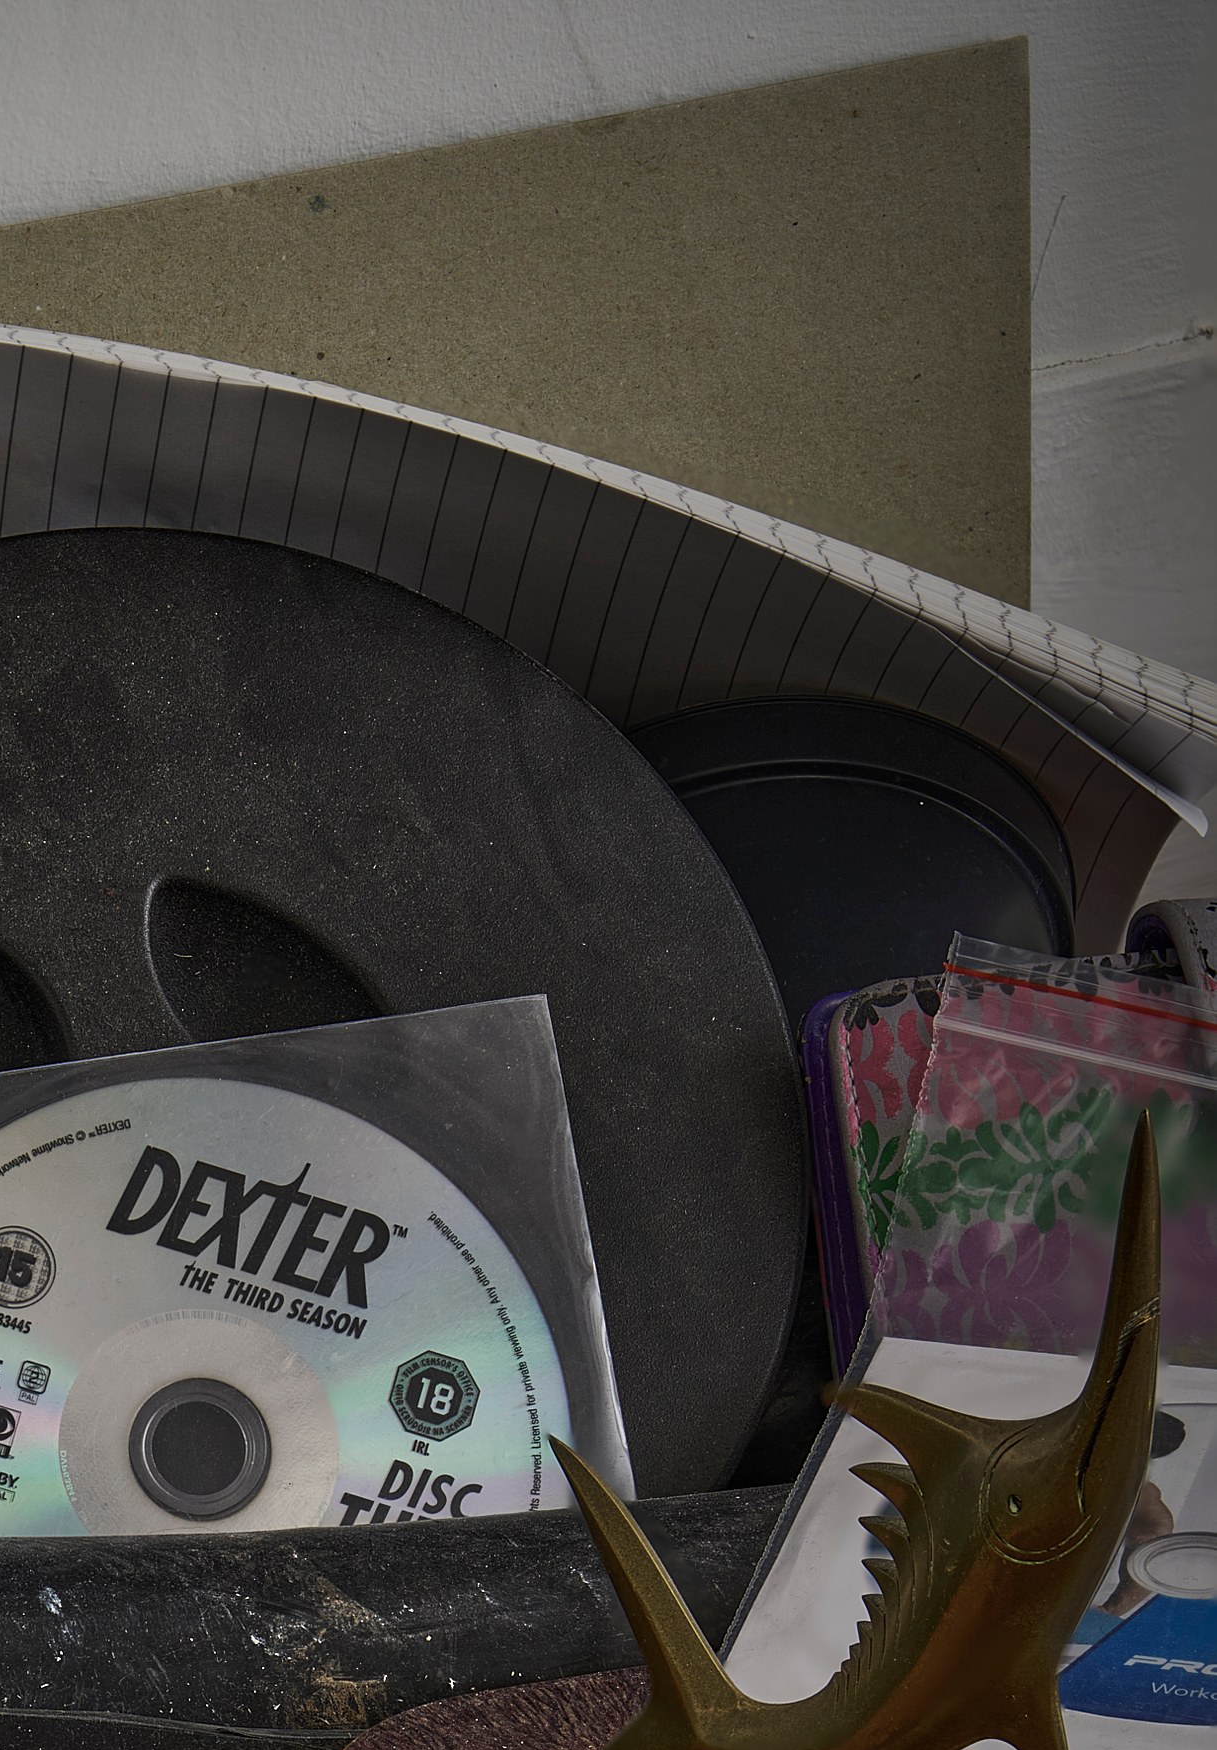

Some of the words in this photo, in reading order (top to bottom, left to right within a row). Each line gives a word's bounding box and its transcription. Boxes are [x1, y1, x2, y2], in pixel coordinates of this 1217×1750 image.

[32, 1136, 75, 1157] Showtime
[106, 1145, 391, 1309] DEXTER
[427, 1211, 466, 1251] prohibited.
[461, 1248, 476, 1265] use
[472, 1264, 490, 1287] other
[180, 1260, 219, 1294] THE
[224, 1277, 284, 1313] THIRD
[286, 1299, 368, 1339] SEASON
[486, 1286, 500, 1305] Any
[496, 1304, 511, 1326] only.
[505, 1325, 524, 1360] viewing
[518, 1360, 535, 1392] private
[21, 1392, 35, 1403] PAL
[416, 1377, 455, 1416] 18
[526, 1393, 535, 1407] for
[529, 1408, 541, 1449] Licensed
[377, 1459, 483, 1518] DISC
[530, 1451, 542, 1496] Reserved.
